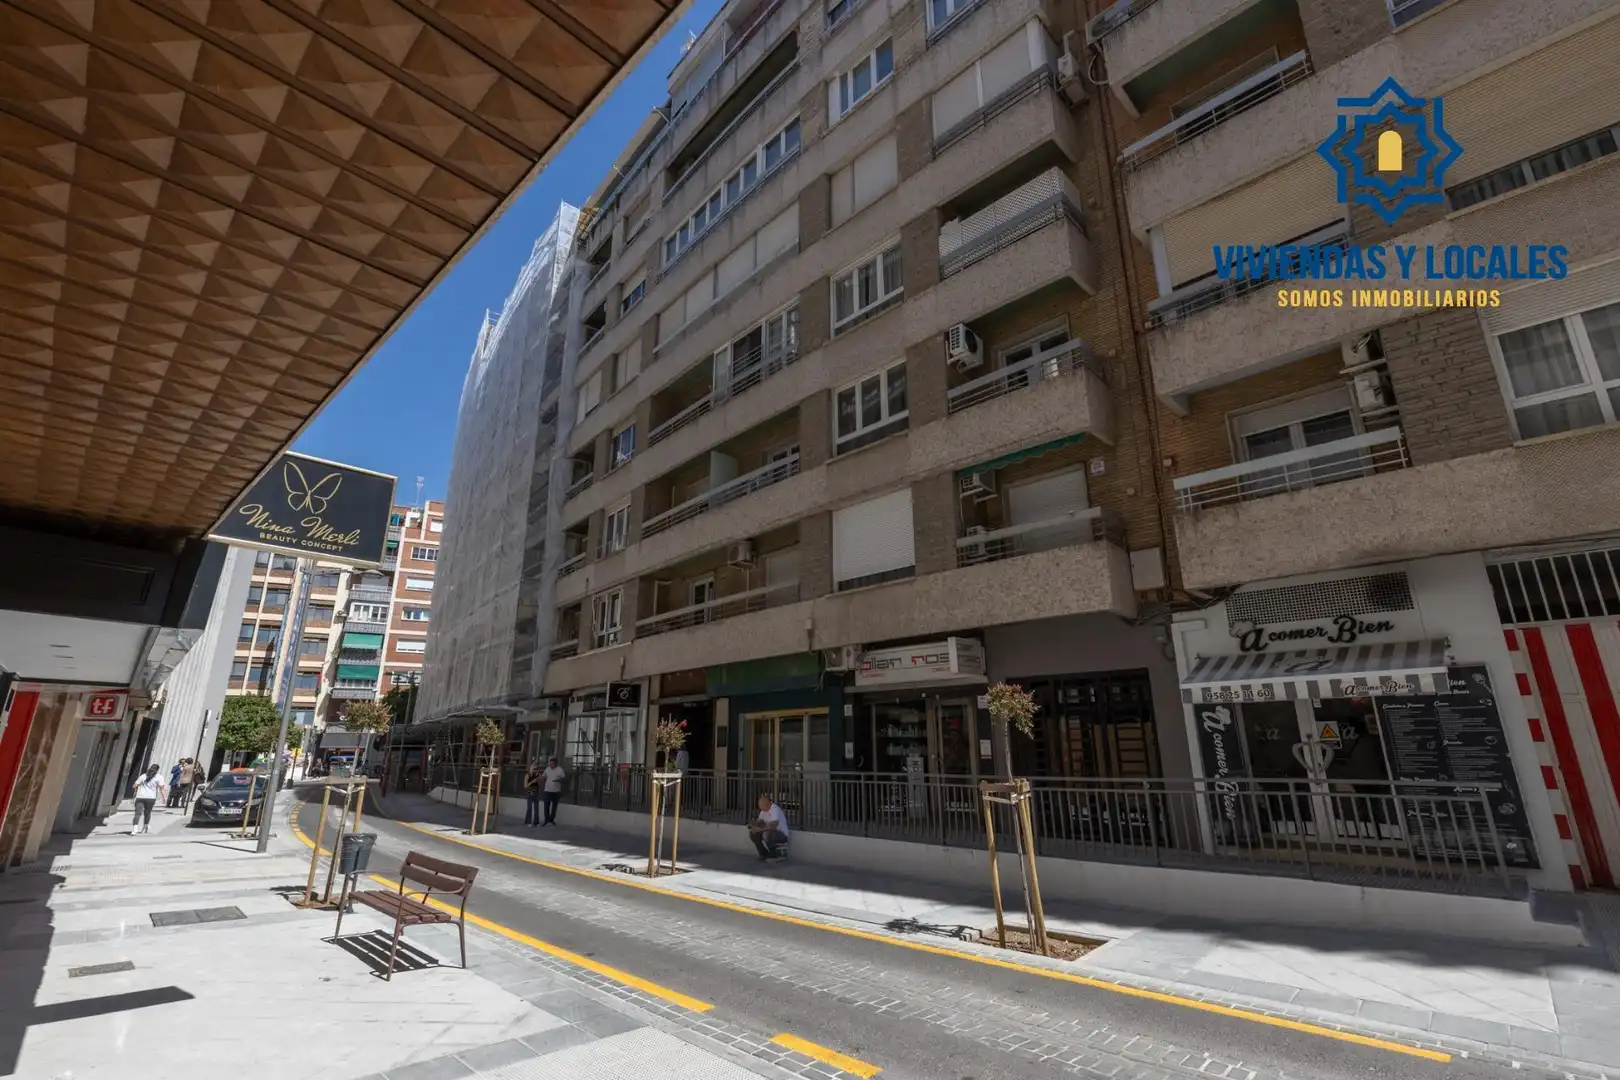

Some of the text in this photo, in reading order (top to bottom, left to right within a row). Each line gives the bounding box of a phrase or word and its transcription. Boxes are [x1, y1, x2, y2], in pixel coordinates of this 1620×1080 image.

[239, 503, 361, 545] Nina Merli
[259, 532, 344, 552] BEAUTY CONCEPT
[1268, 625, 1328, 642] comer
[1327, 615, 1395, 643] Bien
[1206, 687, 1271, 700] 958 25 11 60
[1384, 680, 1415, 694] Bien
